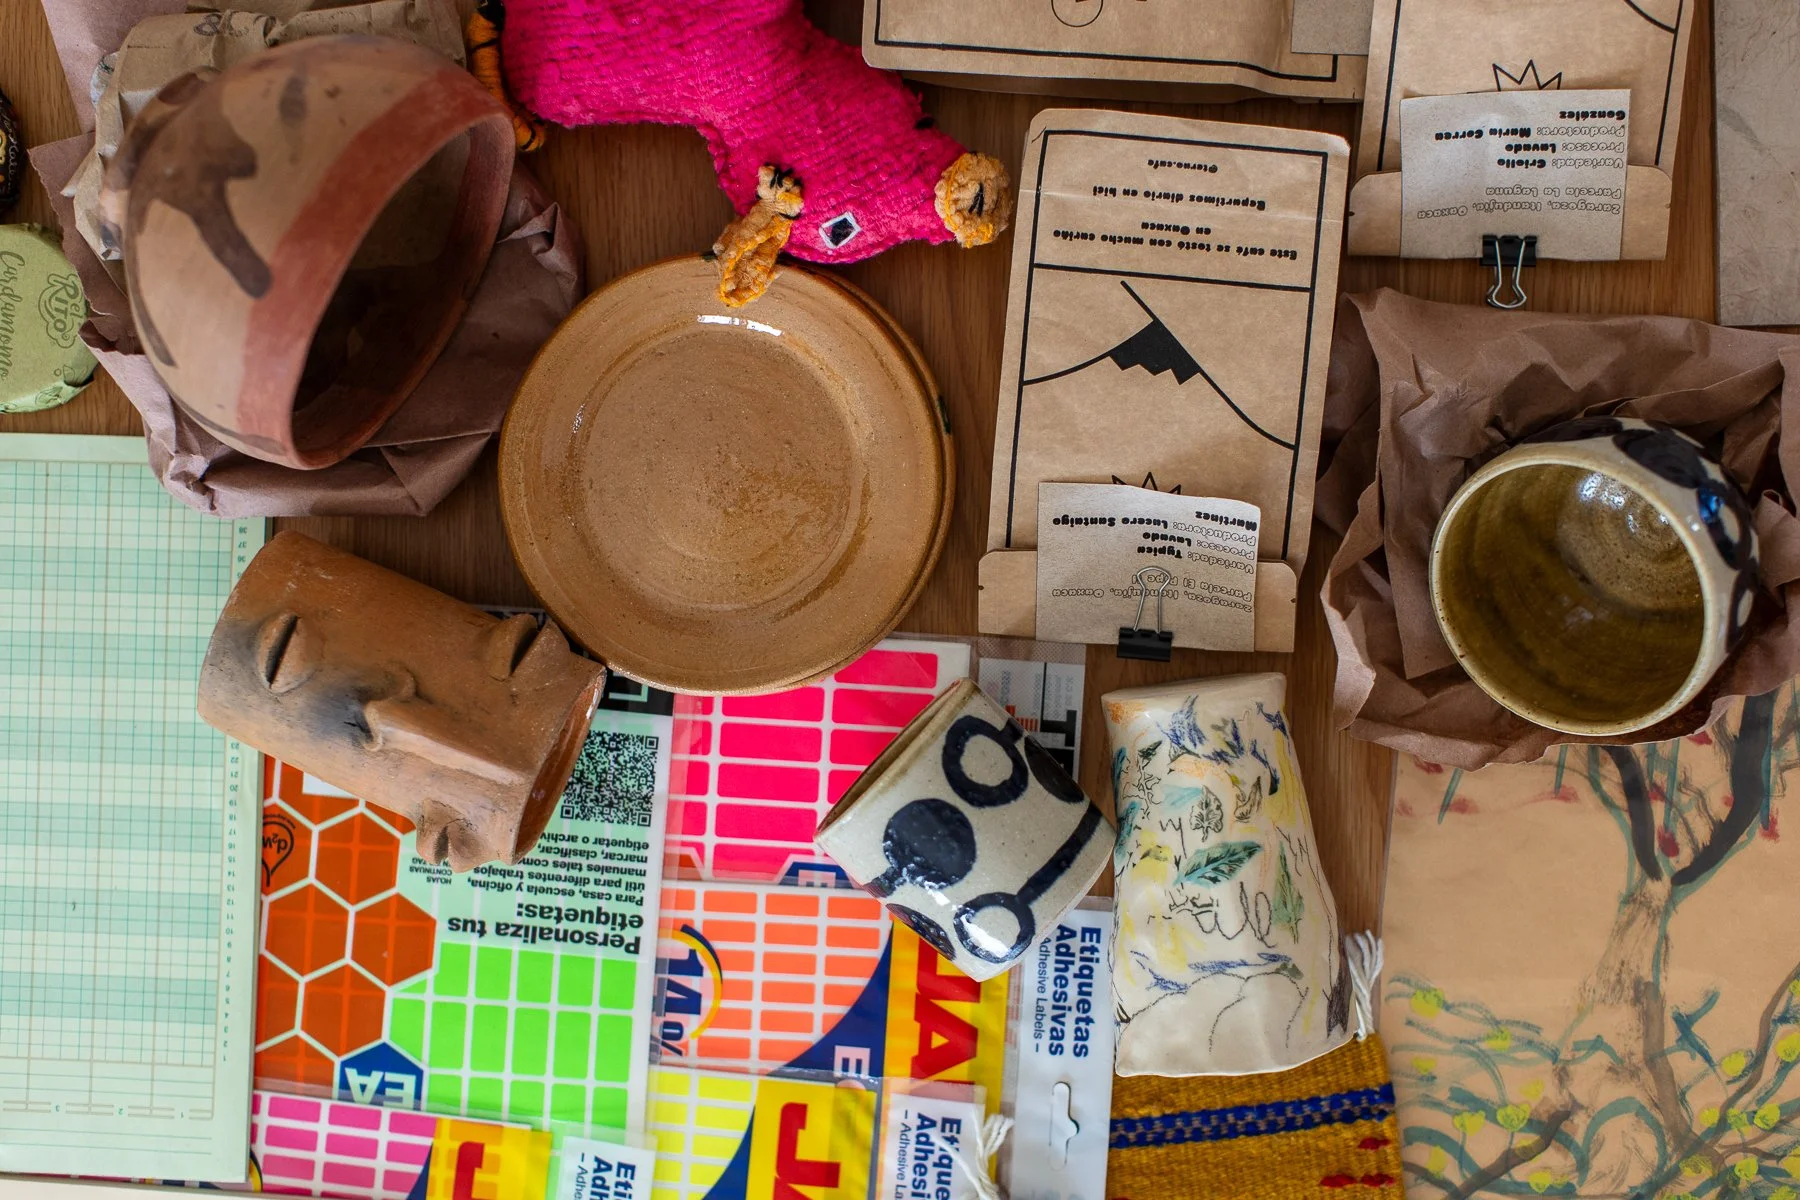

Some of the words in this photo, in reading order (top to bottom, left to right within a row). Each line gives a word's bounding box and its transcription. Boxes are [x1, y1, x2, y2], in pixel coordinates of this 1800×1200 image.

[1559, 110, 1626, 122] González
[1434, 129, 1484, 141] Correa
[1536, 126, 1626, 138] Productora:
[1505, 143, 1557, 154] Lavado
[1561, 142, 1625, 154] Proceso:
[1497, 158, 1546, 169] Criollo
[1551, 157, 1624, 169] Variedad:
[1092, 185, 1117, 197] bici
[1122, 188, 1138, 198] en
[1143, 190, 1184, 204] diario
[1485, 184, 1538, 197] Laguna
[1543, 187, 1560, 198] La
[1566, 187, 1621, 199] Parcela
[1189, 194, 1266, 212] Repartimos
[1547, 200, 1620, 214] Zaragoza,
[1417, 206, 1468, 220] Oaxaca
[1141, 221, 1190, 236] Oaxaca
[1195, 227, 1211, 237] en
[1053, 229, 1096, 243] cariño
[1100, 234, 1144, 246] mucho
[1149, 238, 1172, 249] con
[1177, 240, 1211, 253] tostó
[1216, 244, 1231, 254] se
[1236, 246, 1265, 257] café
[1270, 249, 1297, 261] Este
[0, 251, 26, 380] Cardamomo
[69, 303, 83, 318] el
[1052, 515, 1116, 528] Santaigo
[1121, 517, 1168, 530] Lucero
[1195, 511, 1258, 532] Martínez
[1142, 532, 1192, 547] Lavado
[1172, 522, 1256, 547] Productora:
[1137, 546, 1182, 559] Typica
[1196, 540, 1255, 561] Proceso:
[1187, 551, 1254, 574] Variedad:
[1183, 577, 1195, 590] El
[1051, 588, 1104, 598] Oaxaca
[1200, 582, 1252, 602] Parcela
[1184, 591, 1252, 613] Zaragoza,
[581, 836, 588, 844] o
[592, 834, 649, 851] etiquetar
[537, 843, 598, 860] clasificar,
[600, 850, 648, 864] marcar,
[409, 865, 453, 876] CONTINUAS
[473, 865, 524, 881] trabajos
[552, 860, 583, 873] tales
[586, 863, 647, 878] manuales
[426, 876, 452, 885] HOJAS
[467, 877, 513, 892] oficina,
[528, 872, 590, 888] diferentes
[594, 877, 622, 889] para
[515, 882, 524, 893] y
[527, 884, 575, 898] escuela
[625, 881, 645, 893] útil
[578, 888, 612, 902] casa,
[616, 894, 644, 906] Para
[516, 903, 644, 930] etiquetas:
[447, 917, 487, 937] tus
[495, 921, 641, 955] Personaliza
[1036, 937, 1052, 994] Adhesive
[1048, 924, 1077, 1056] Adhesivas
[1073, 926, 1102, 1058] Etiquetas
[1033, 998, 1049, 1039] Labels
[896, 1122, 912, 1180] Adhesive
